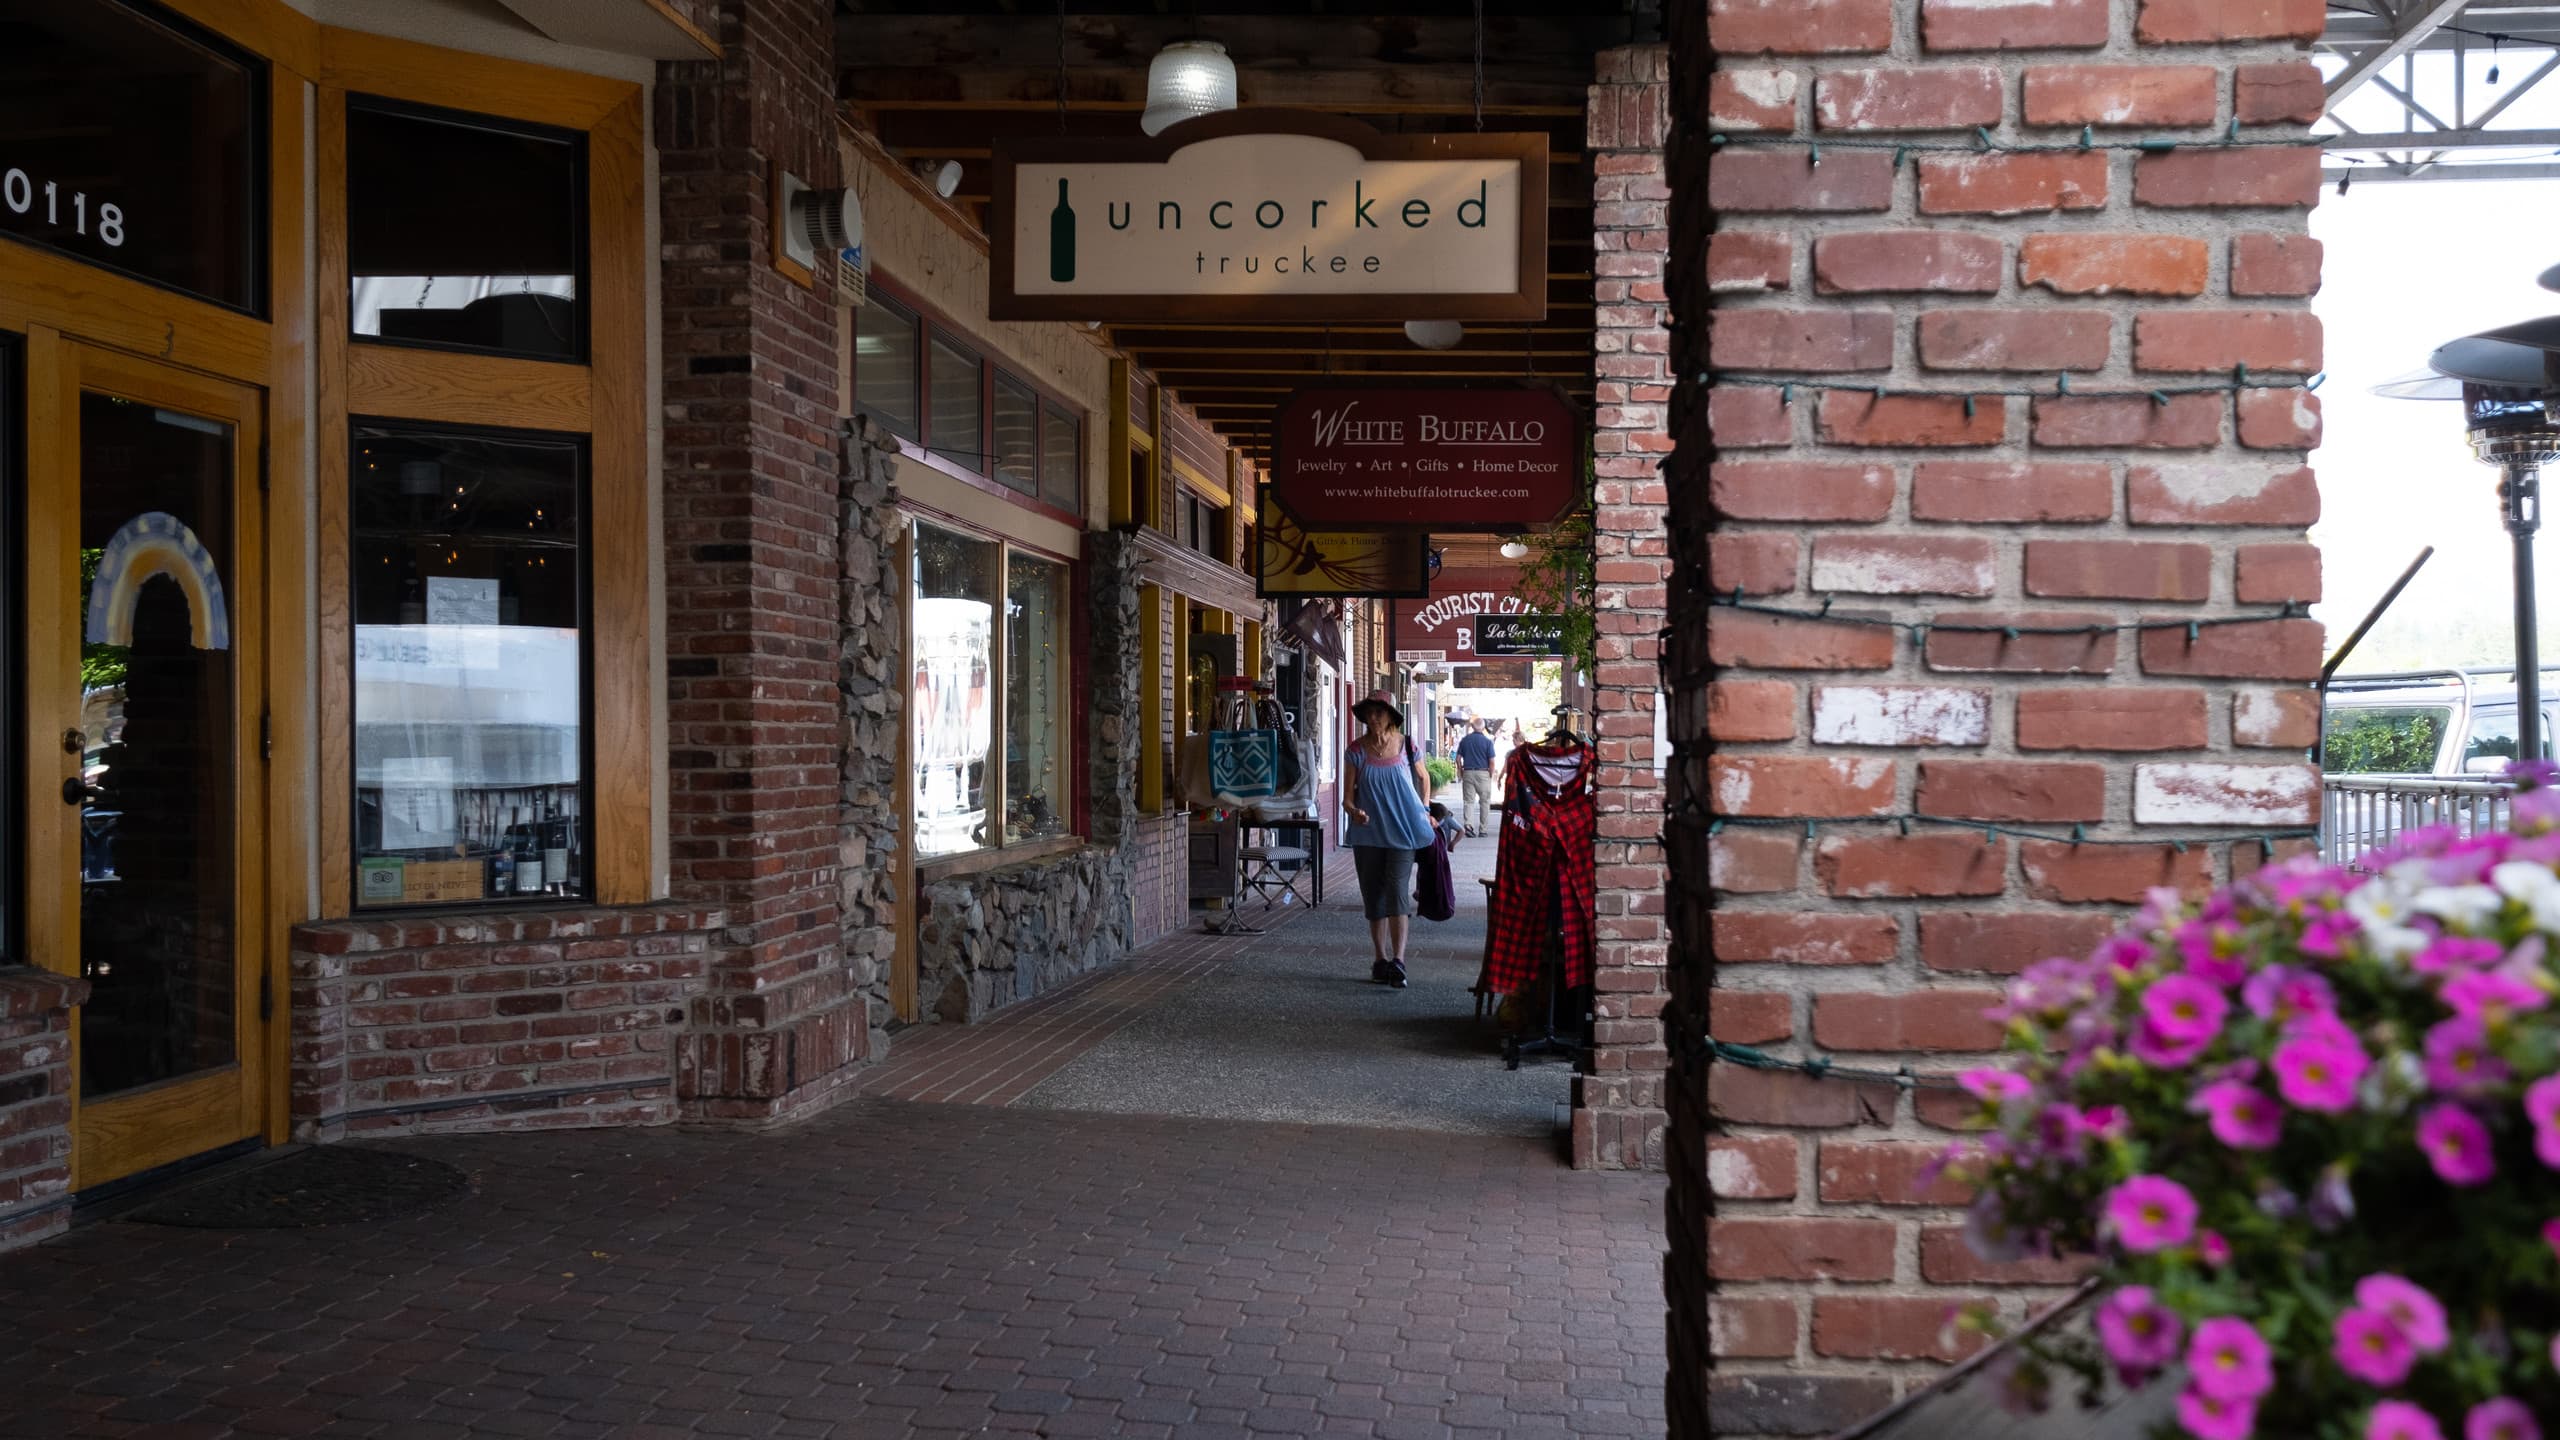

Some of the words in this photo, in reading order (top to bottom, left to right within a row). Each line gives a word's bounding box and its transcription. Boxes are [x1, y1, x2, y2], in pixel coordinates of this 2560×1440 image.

[1107, 179, 1487, 230] uncorked
[1196, 245, 1381, 274] truckee
[1296, 459, 1347, 474] Jewelry
[1370, 459, 1393, 472] Art
[1416, 459, 1449, 472] Gifts
[1472, 459, 1515, 473] Home
[1518, 459, 1559, 473] Decor
[1324, 486, 1530, 499] www.whitebuffalotruckee.com
[1316, 537, 1337, 545] Gifts
[1339, 537, 1347, 545] &
[1351, 537, 1376, 545] Home
[1413, 592, 1495, 633] TOURIST
[1485, 624, 1507, 639] La
